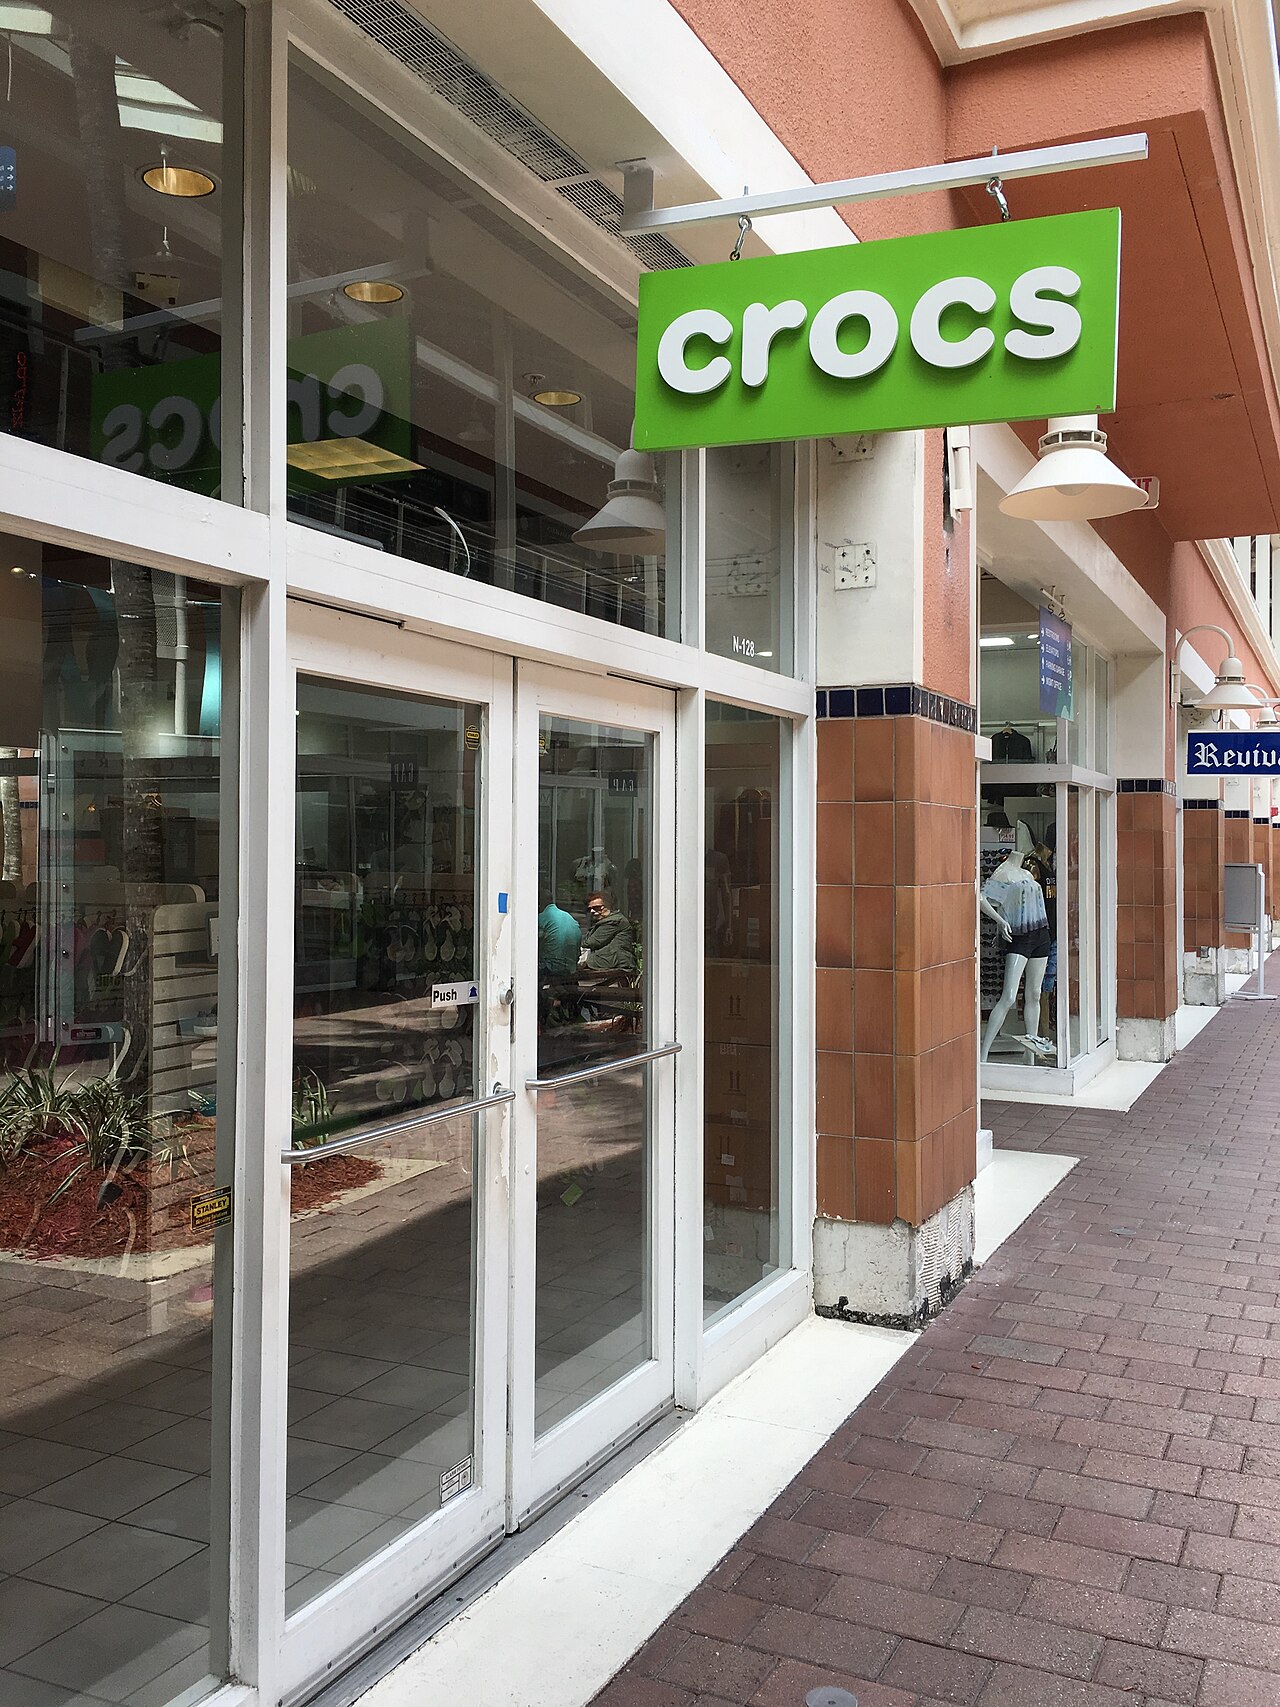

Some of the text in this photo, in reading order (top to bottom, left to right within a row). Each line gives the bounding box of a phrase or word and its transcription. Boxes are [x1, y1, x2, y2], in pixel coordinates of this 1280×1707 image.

[657, 265, 1082, 394] crocs
[732, 635, 755, 658] N-128
[1193, 742, 1280, 768] Reviv
[433, 989, 457, 1002] Push
[196, 1199, 227, 1215] STANLEY
